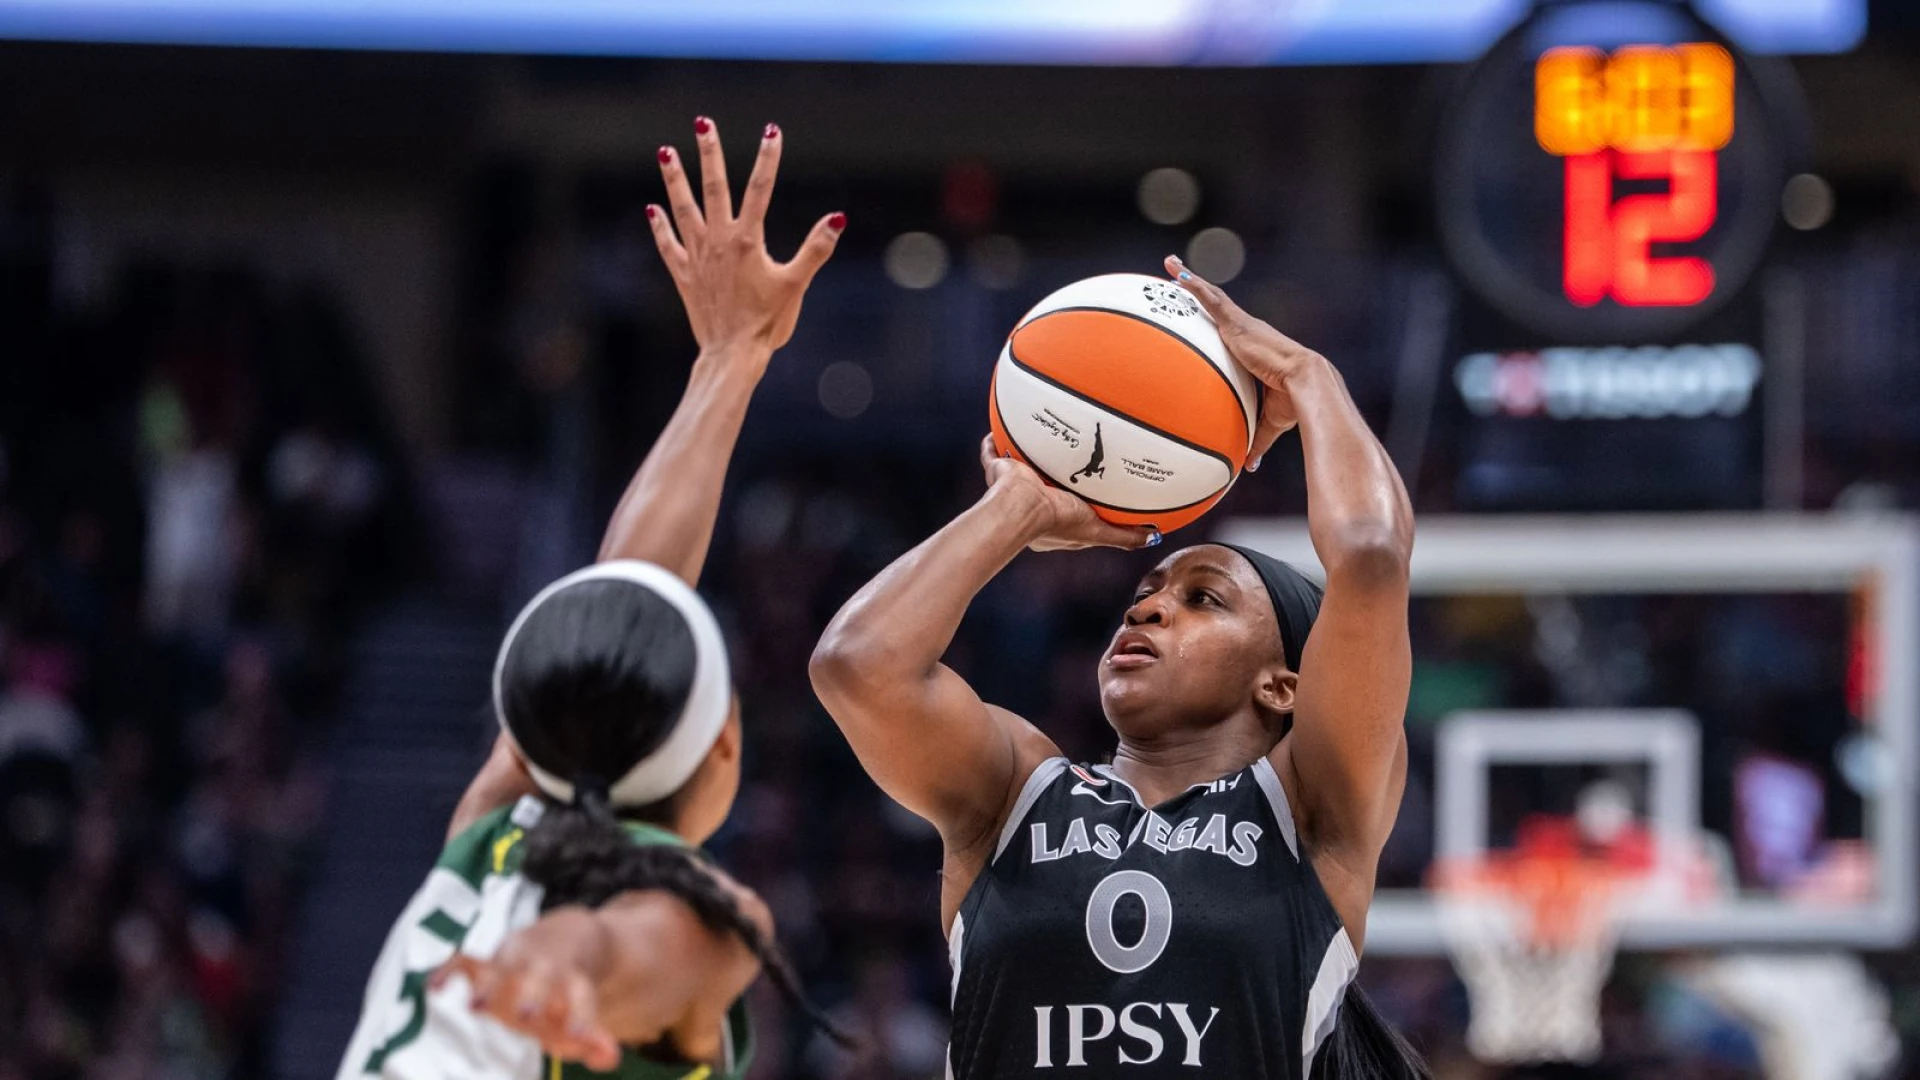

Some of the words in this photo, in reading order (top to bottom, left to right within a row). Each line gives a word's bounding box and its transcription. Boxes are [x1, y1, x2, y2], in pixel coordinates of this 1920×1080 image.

[1564, 152, 1718, 307] 12
[1121, 457, 1145, 470] BALL
[1124, 467, 1165, 482] OFFICIAL
[1146, 466, 1174, 477] GAME
[1031, 816, 1122, 864] LAS
[1085, 869, 1173, 974] 0
[1034, 1001, 1220, 1069] IPSY
